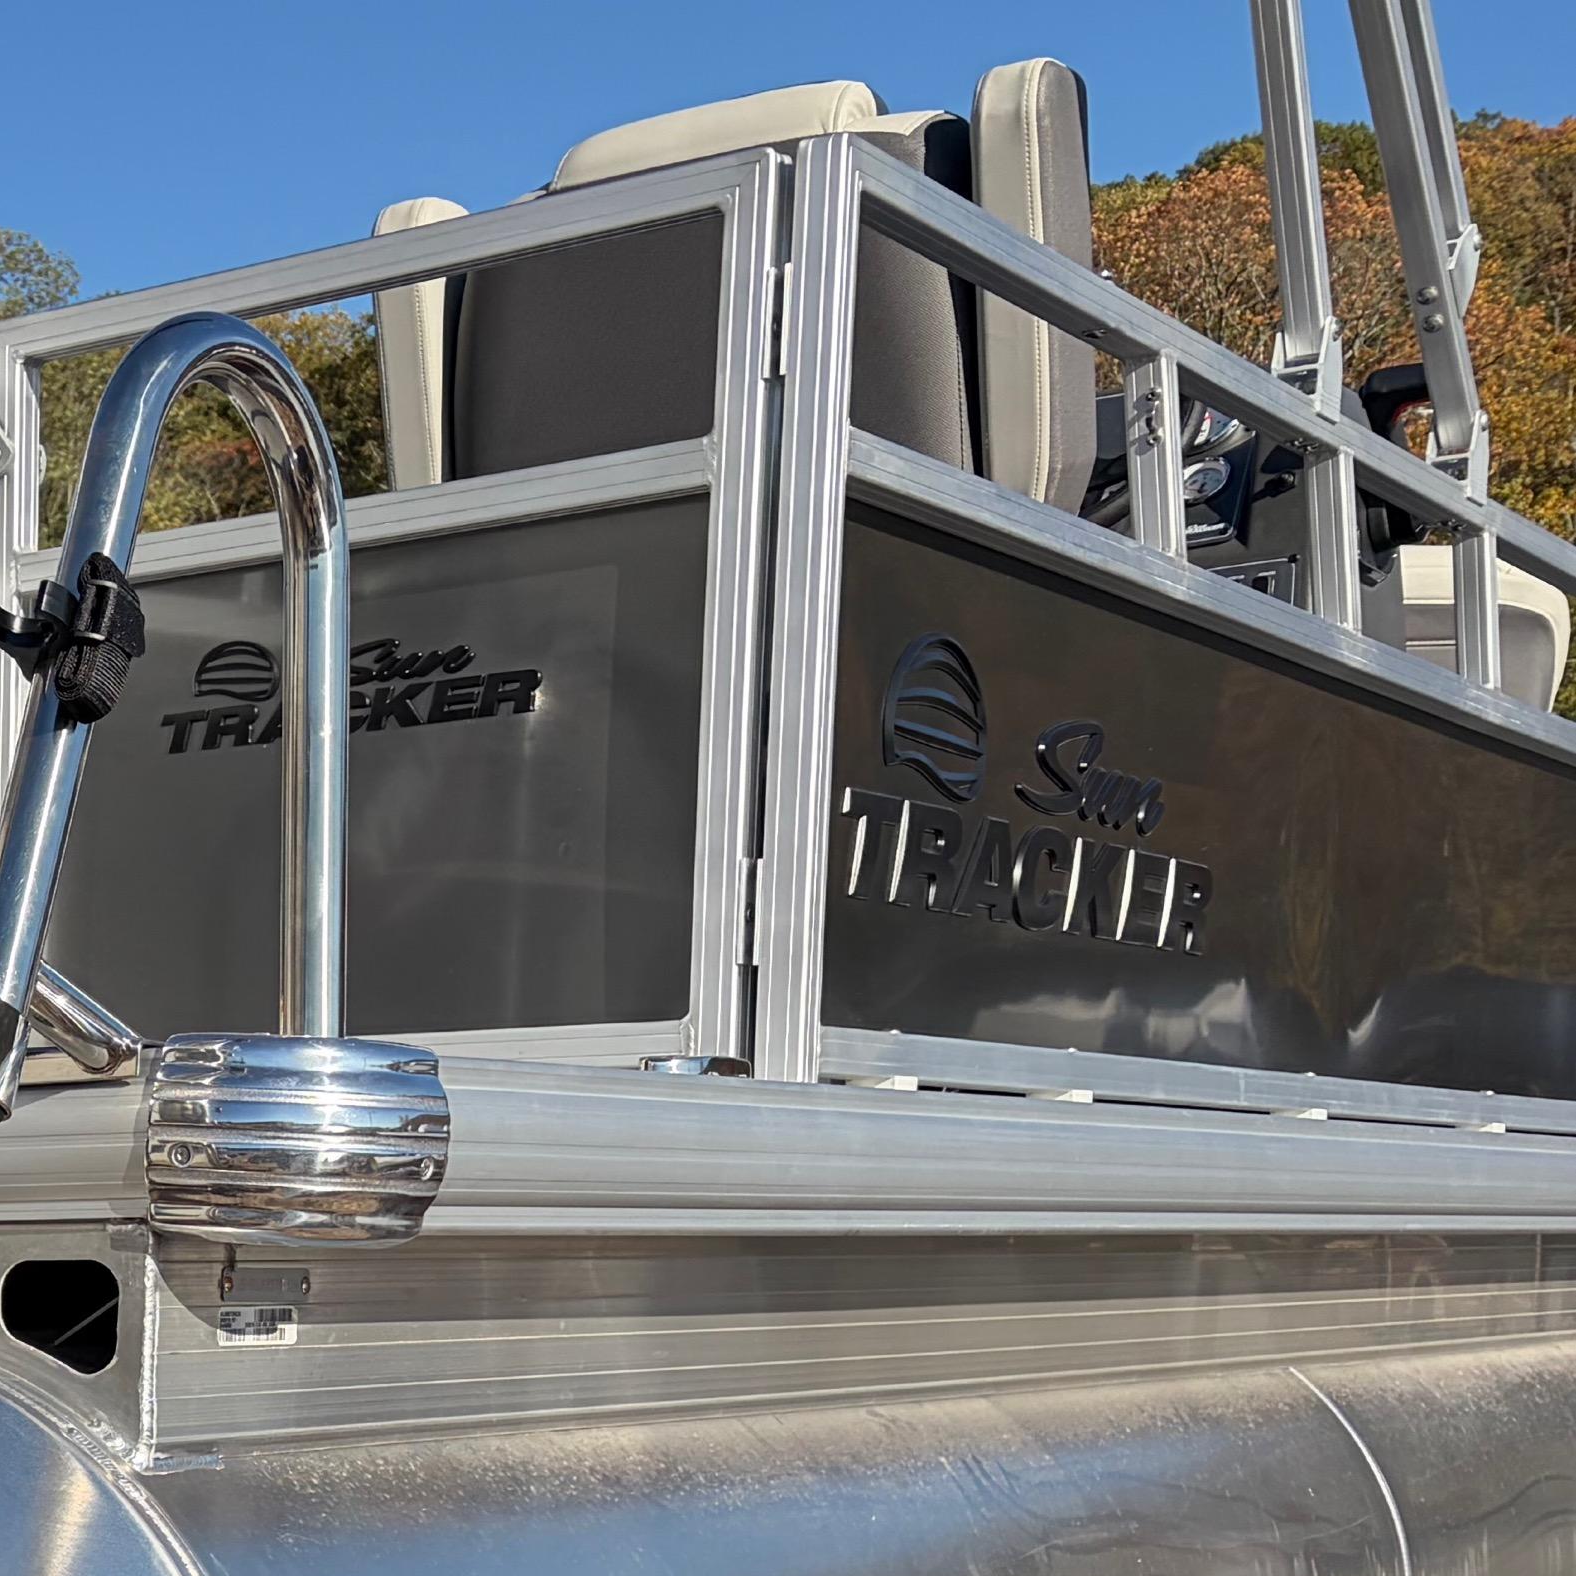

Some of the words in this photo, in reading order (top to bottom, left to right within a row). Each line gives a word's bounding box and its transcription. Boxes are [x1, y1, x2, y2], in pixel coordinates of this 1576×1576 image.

[348, 637, 477, 687] Sun
[1013, 720, 1166, 837] Sun
[841, 786, 1214, 957] TRACKER
